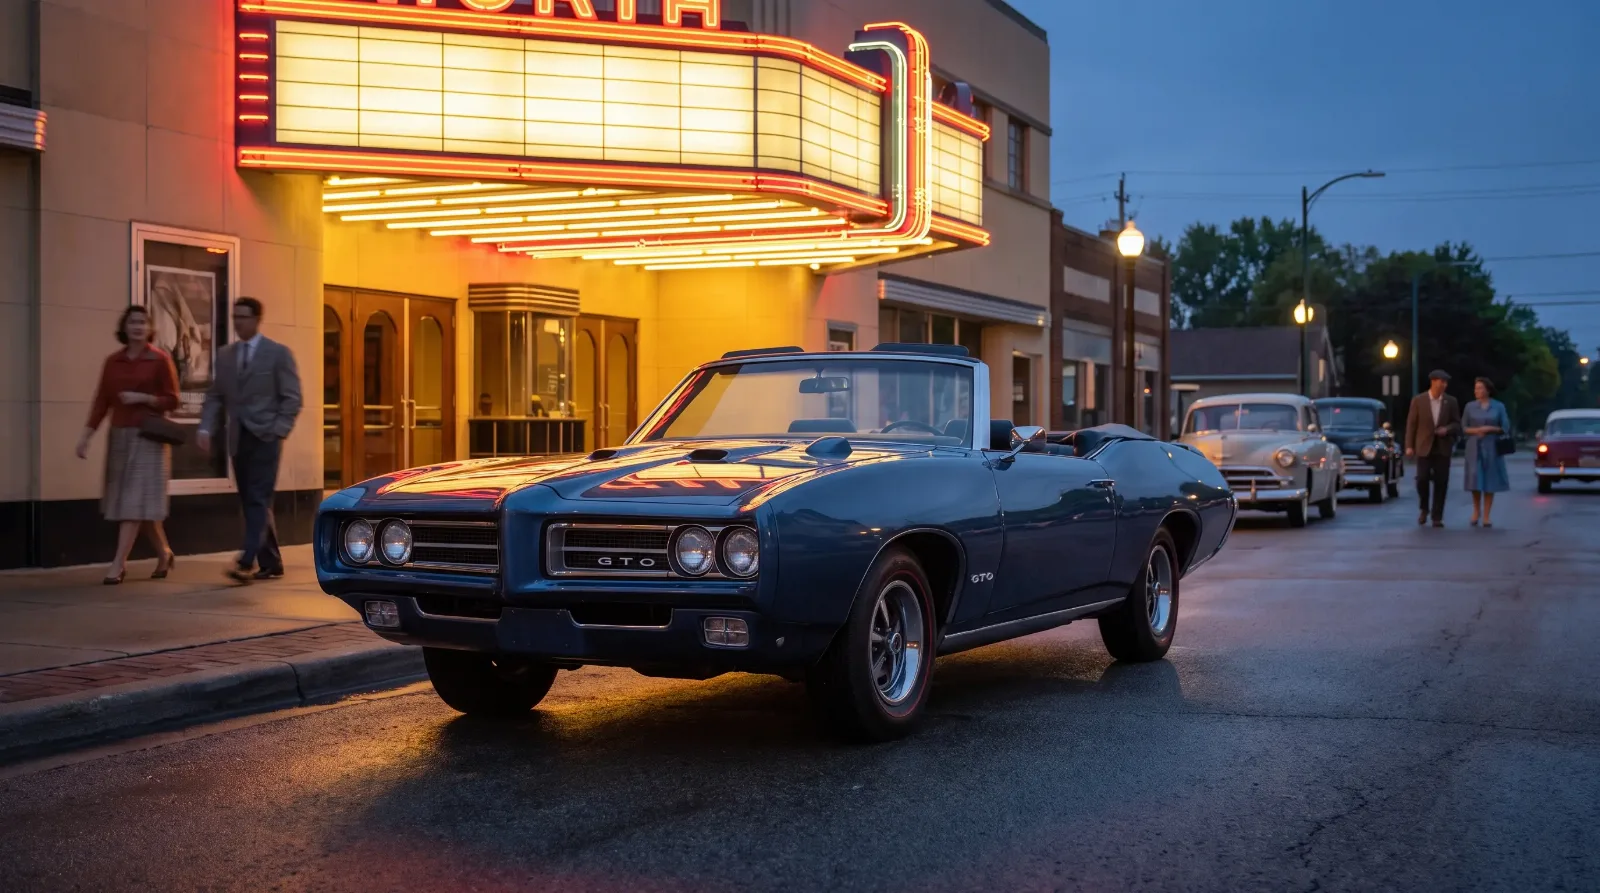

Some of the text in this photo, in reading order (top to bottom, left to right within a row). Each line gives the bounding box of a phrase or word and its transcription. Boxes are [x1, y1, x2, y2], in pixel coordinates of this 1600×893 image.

[376, 0, 721, 30] RTH
[598, 557, 655, 567] GTO
[971, 572, 994, 583] GTO
